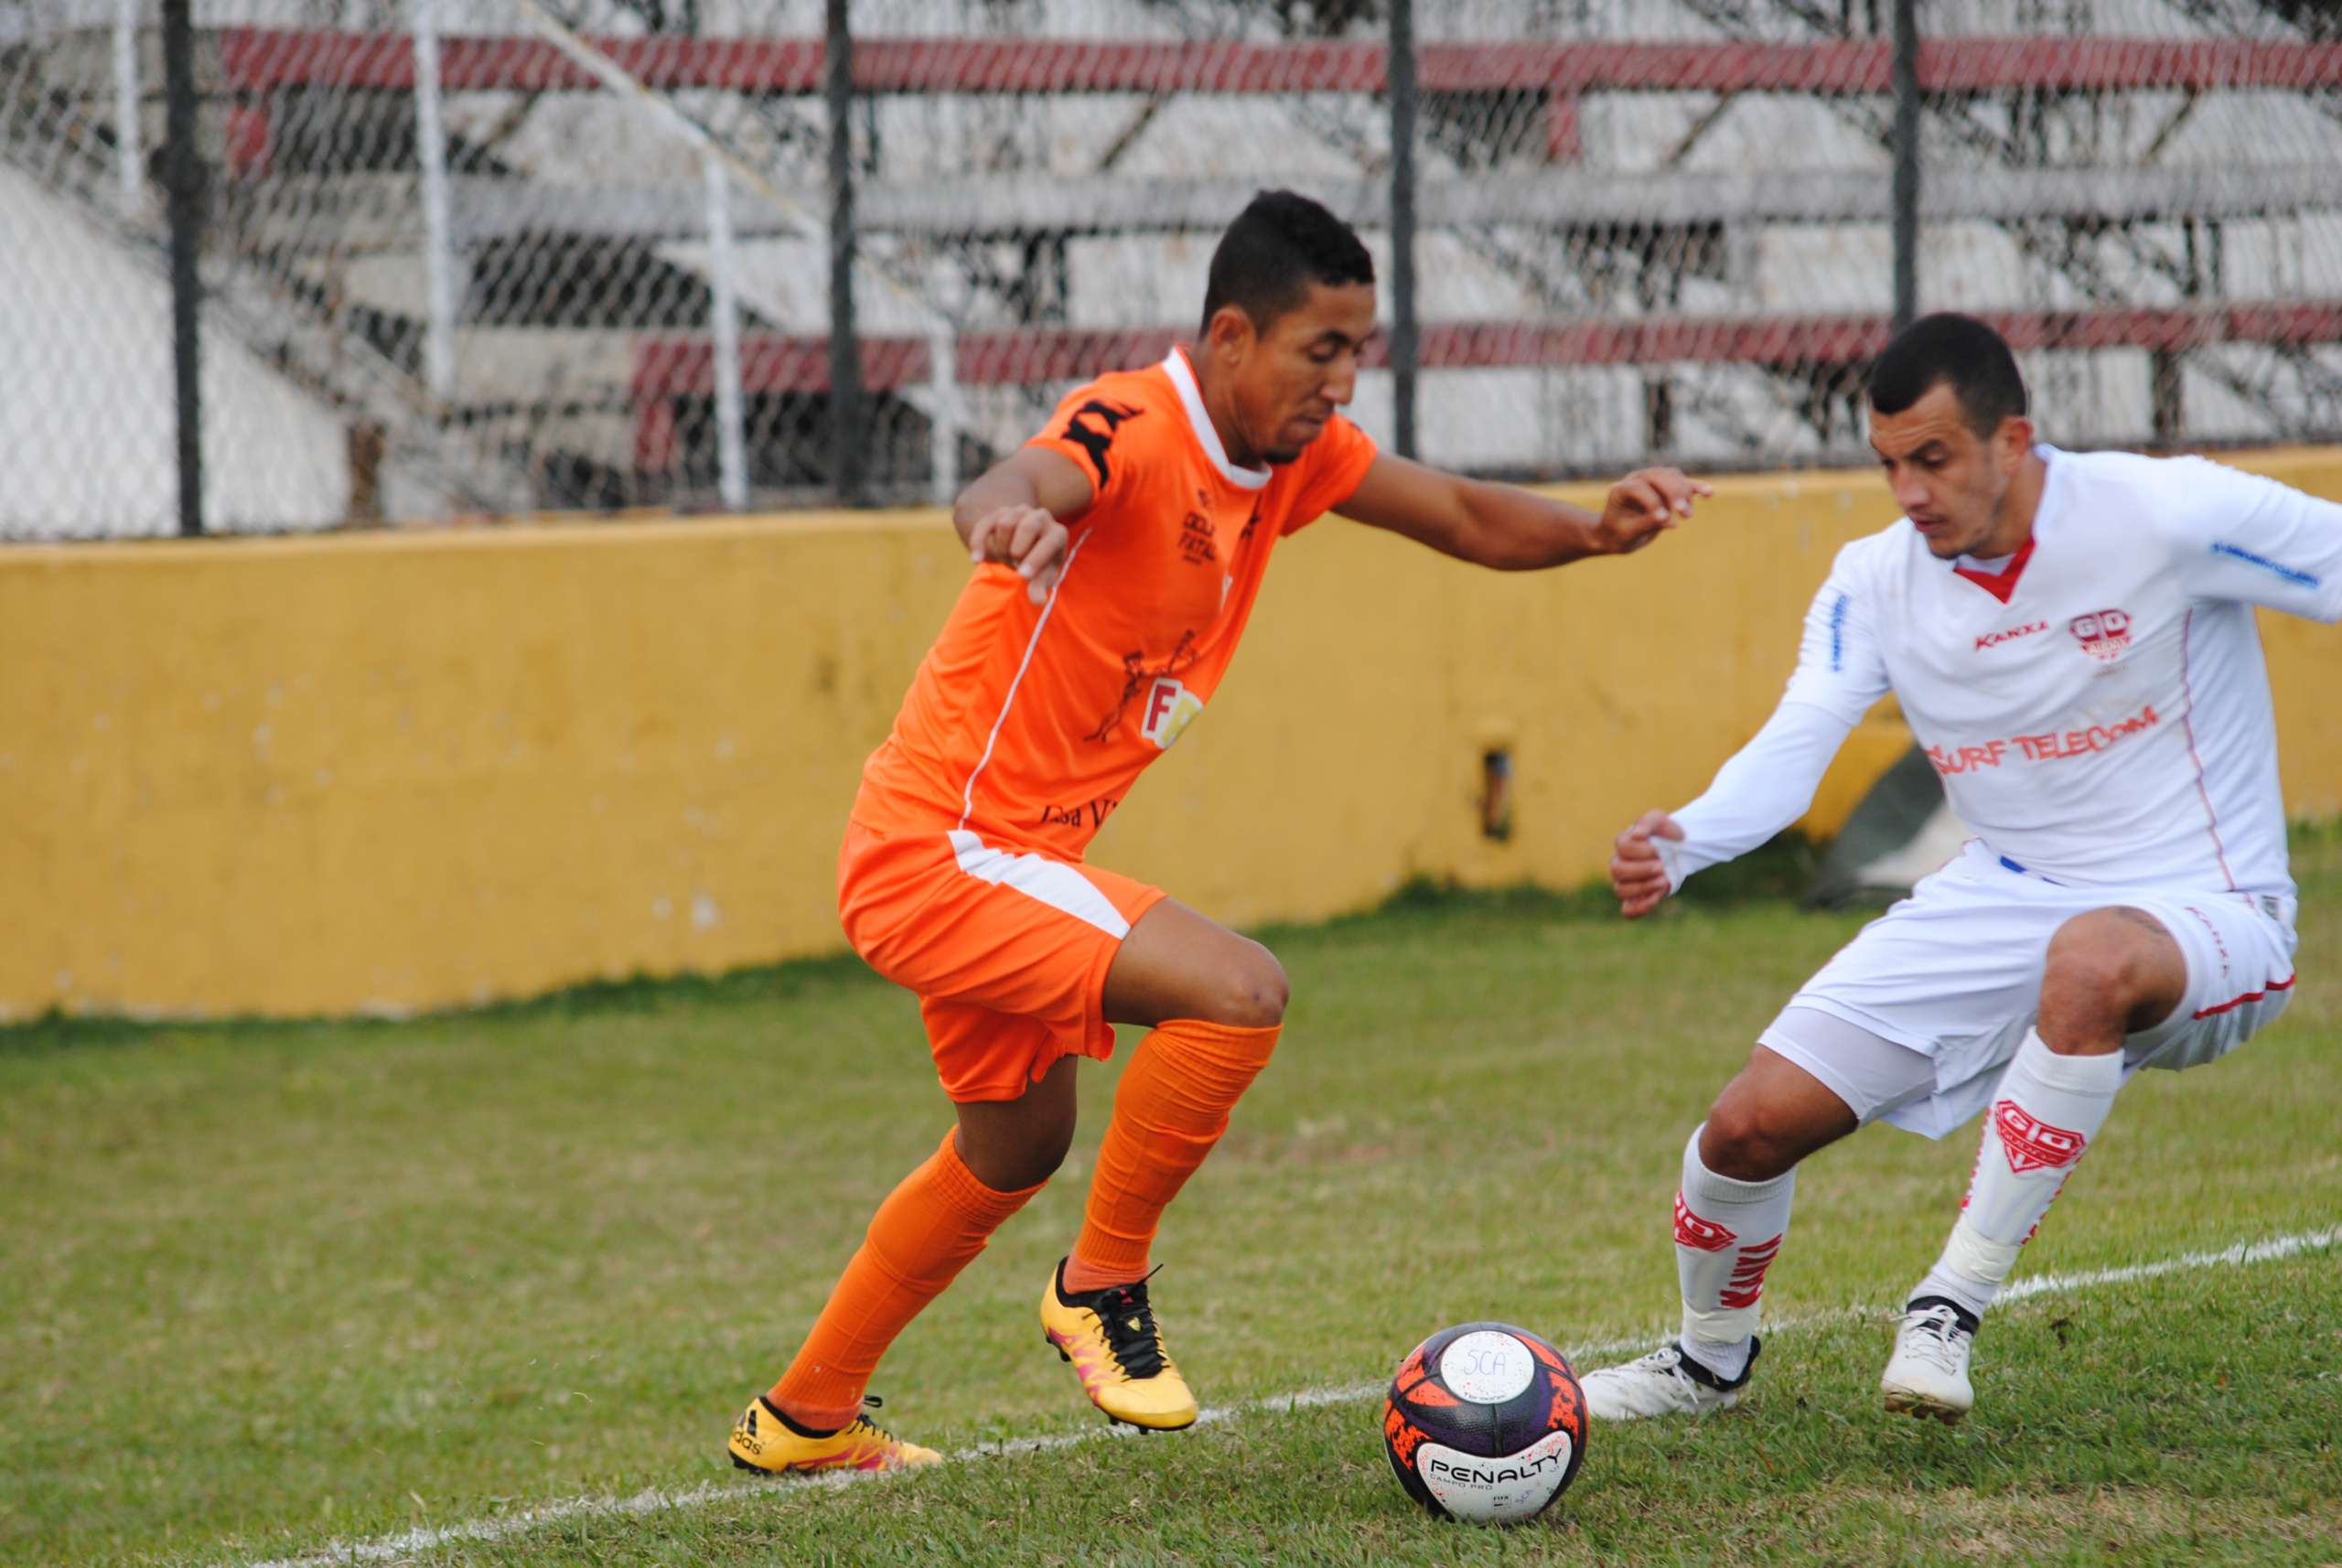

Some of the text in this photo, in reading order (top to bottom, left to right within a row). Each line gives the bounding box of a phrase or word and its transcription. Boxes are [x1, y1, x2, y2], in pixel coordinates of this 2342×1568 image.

[1974, 619, 2049, 651] KANXA
[1463, 1348, 1507, 1377] SCA
[1430, 1448, 1563, 1484] PENALTY
[1429, 1473, 1493, 1491] CAMPO PRO
